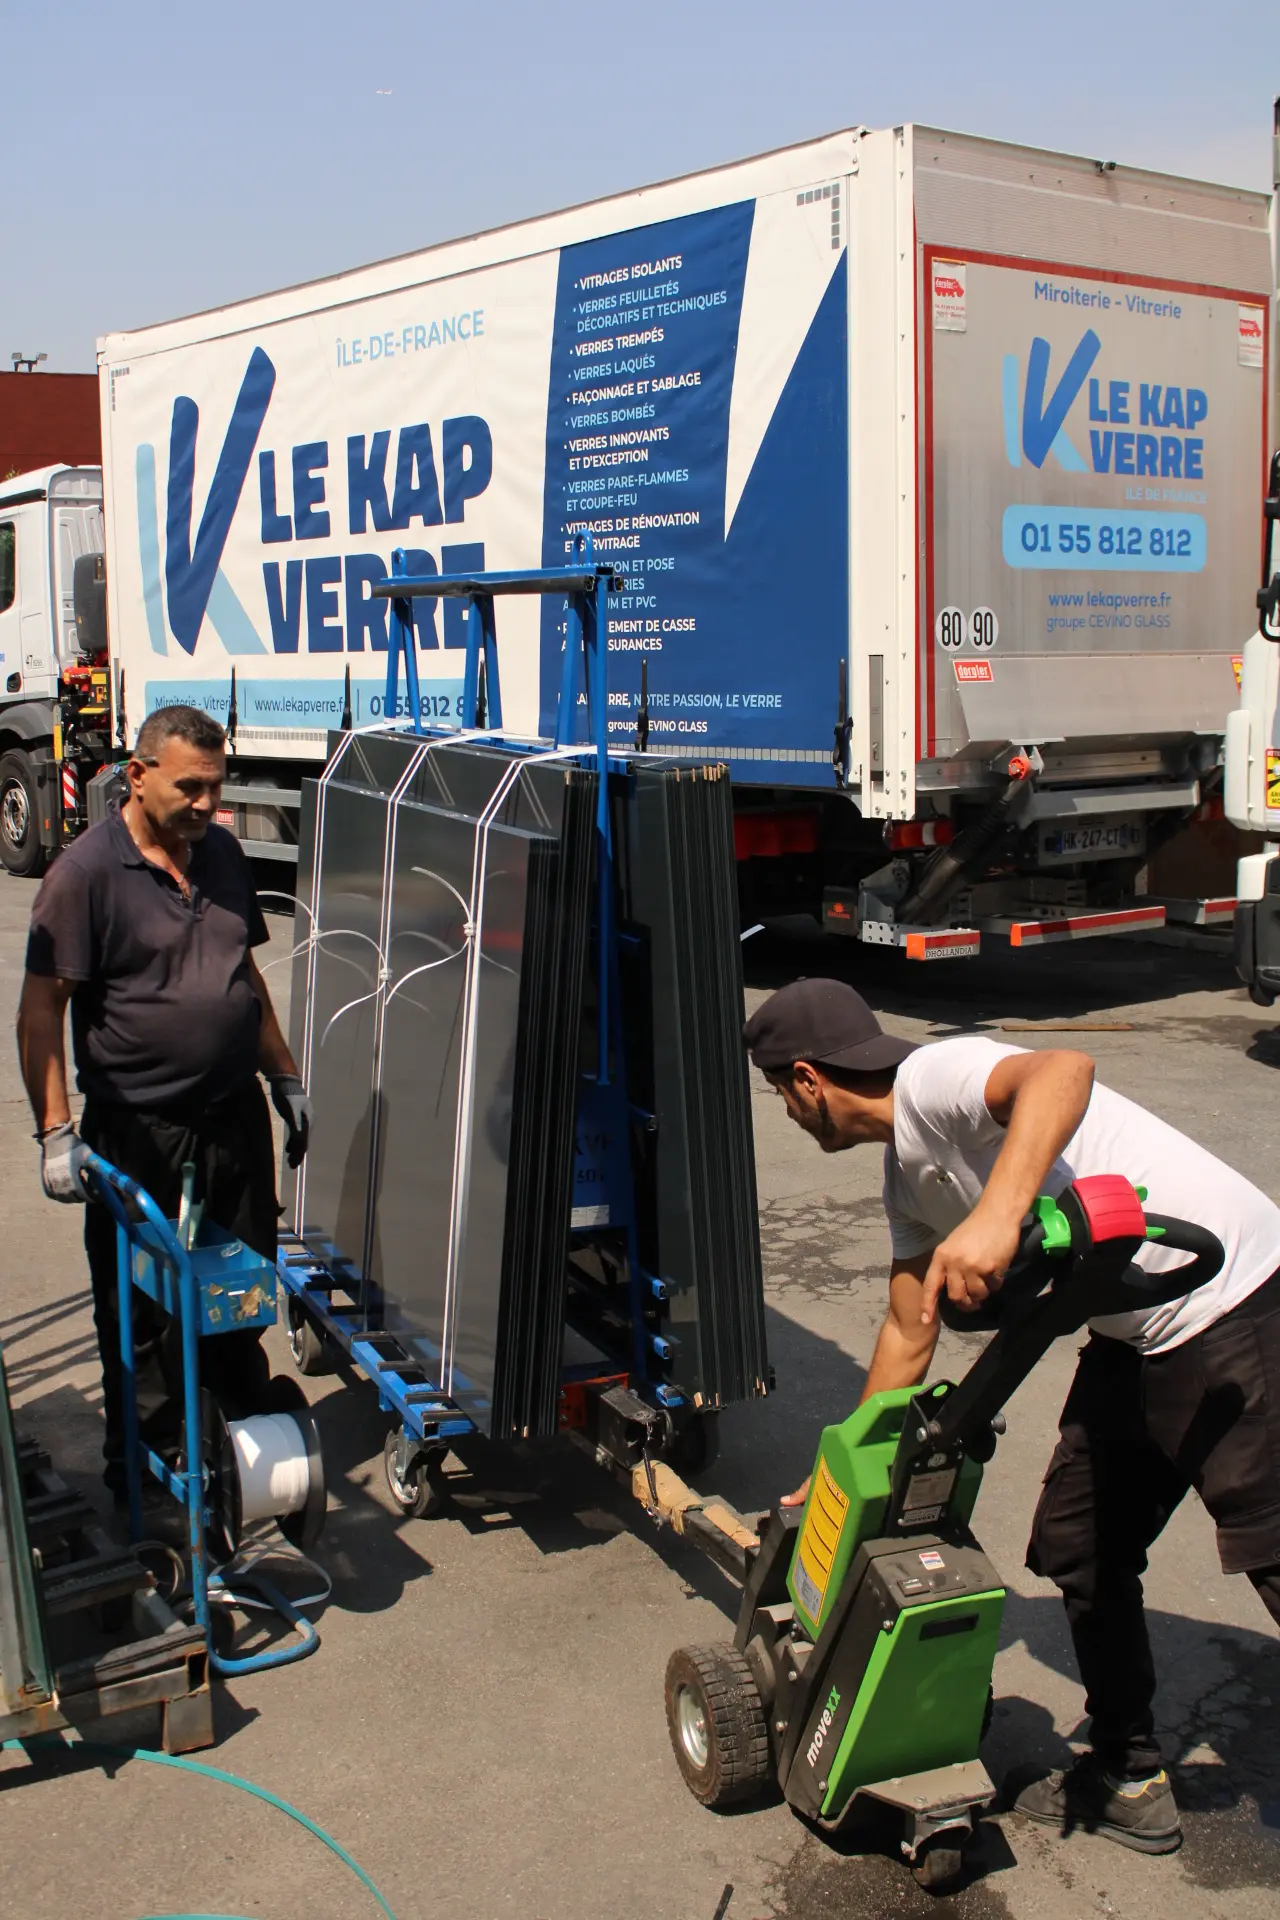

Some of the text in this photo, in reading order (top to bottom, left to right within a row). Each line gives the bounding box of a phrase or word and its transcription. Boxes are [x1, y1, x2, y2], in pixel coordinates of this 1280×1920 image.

[579, 255, 683, 290] VITRAGES ISOLANTS
[578, 280, 679, 315] VERRES FEUILLETÉS
[1034, 280, 1111, 309] Miroiterie
[1125, 294, 1182, 319] Vitrerie
[577, 291, 728, 333] DÉCORATIFS ET TECHNIQUES
[335, 310, 485, 368] ÎLE-DE-FRANCE
[575, 326, 665, 357] VERRES TREMPÉS
[573, 353, 656, 381] VERRES LAQUÉS
[572, 372, 701, 405] FAÇONNAGE ET SABLAGE
[570, 402, 656, 428] VERRES BOMBÉS
[1089, 378, 1208, 430] LE KAP
[569, 427, 670, 452] VERRES INNOVANTS
[569, 449, 649, 470] ET D'EXCEPTION
[1089, 429, 1204, 480] VERRE
[258, 415, 493, 544] LE KAP
[567, 469, 689, 494] VERRES PARE-FLAMMES
[566, 493, 638, 512] ET COUPE-FEU
[565, 511, 700, 535] VITRAGES DE RÉNOVATION
[579, 535, 641, 552] SRVITRAGE
[1021, 523, 1192, 557] 01 55 812 812
[632, 560, 645, 572] ET
[647, 557, 675, 571] POSE
[262, 542, 485, 654] VERRE
[621, 597, 634, 609] ET
[636, 595, 657, 609] PVC
[645, 619, 660, 632] DE
[662, 618, 696, 632] CASSE
[941, 611, 962, 647] 80
[973, 611, 994, 647] 90
[1046, 614, 1171, 633] groupe CEVINO GLASS
[604, 638, 663, 651] SURANCES
[957, 664, 989, 678] dorgler
[254, 696, 345, 716] www.lekapverre.f
[420, 696, 451, 717] 812
[605, 693, 631, 708] RRE,
[673, 694, 723, 709] PASSION,
[725, 694, 739, 707] LE
[743, 694, 782, 708] VERRE
[646, 720, 676, 732] EVINO
[678, 721, 708, 733] GLASS
[925, 946, 973, 959] DHOLLANDIA
[806, 1684, 841, 1768] movexx
